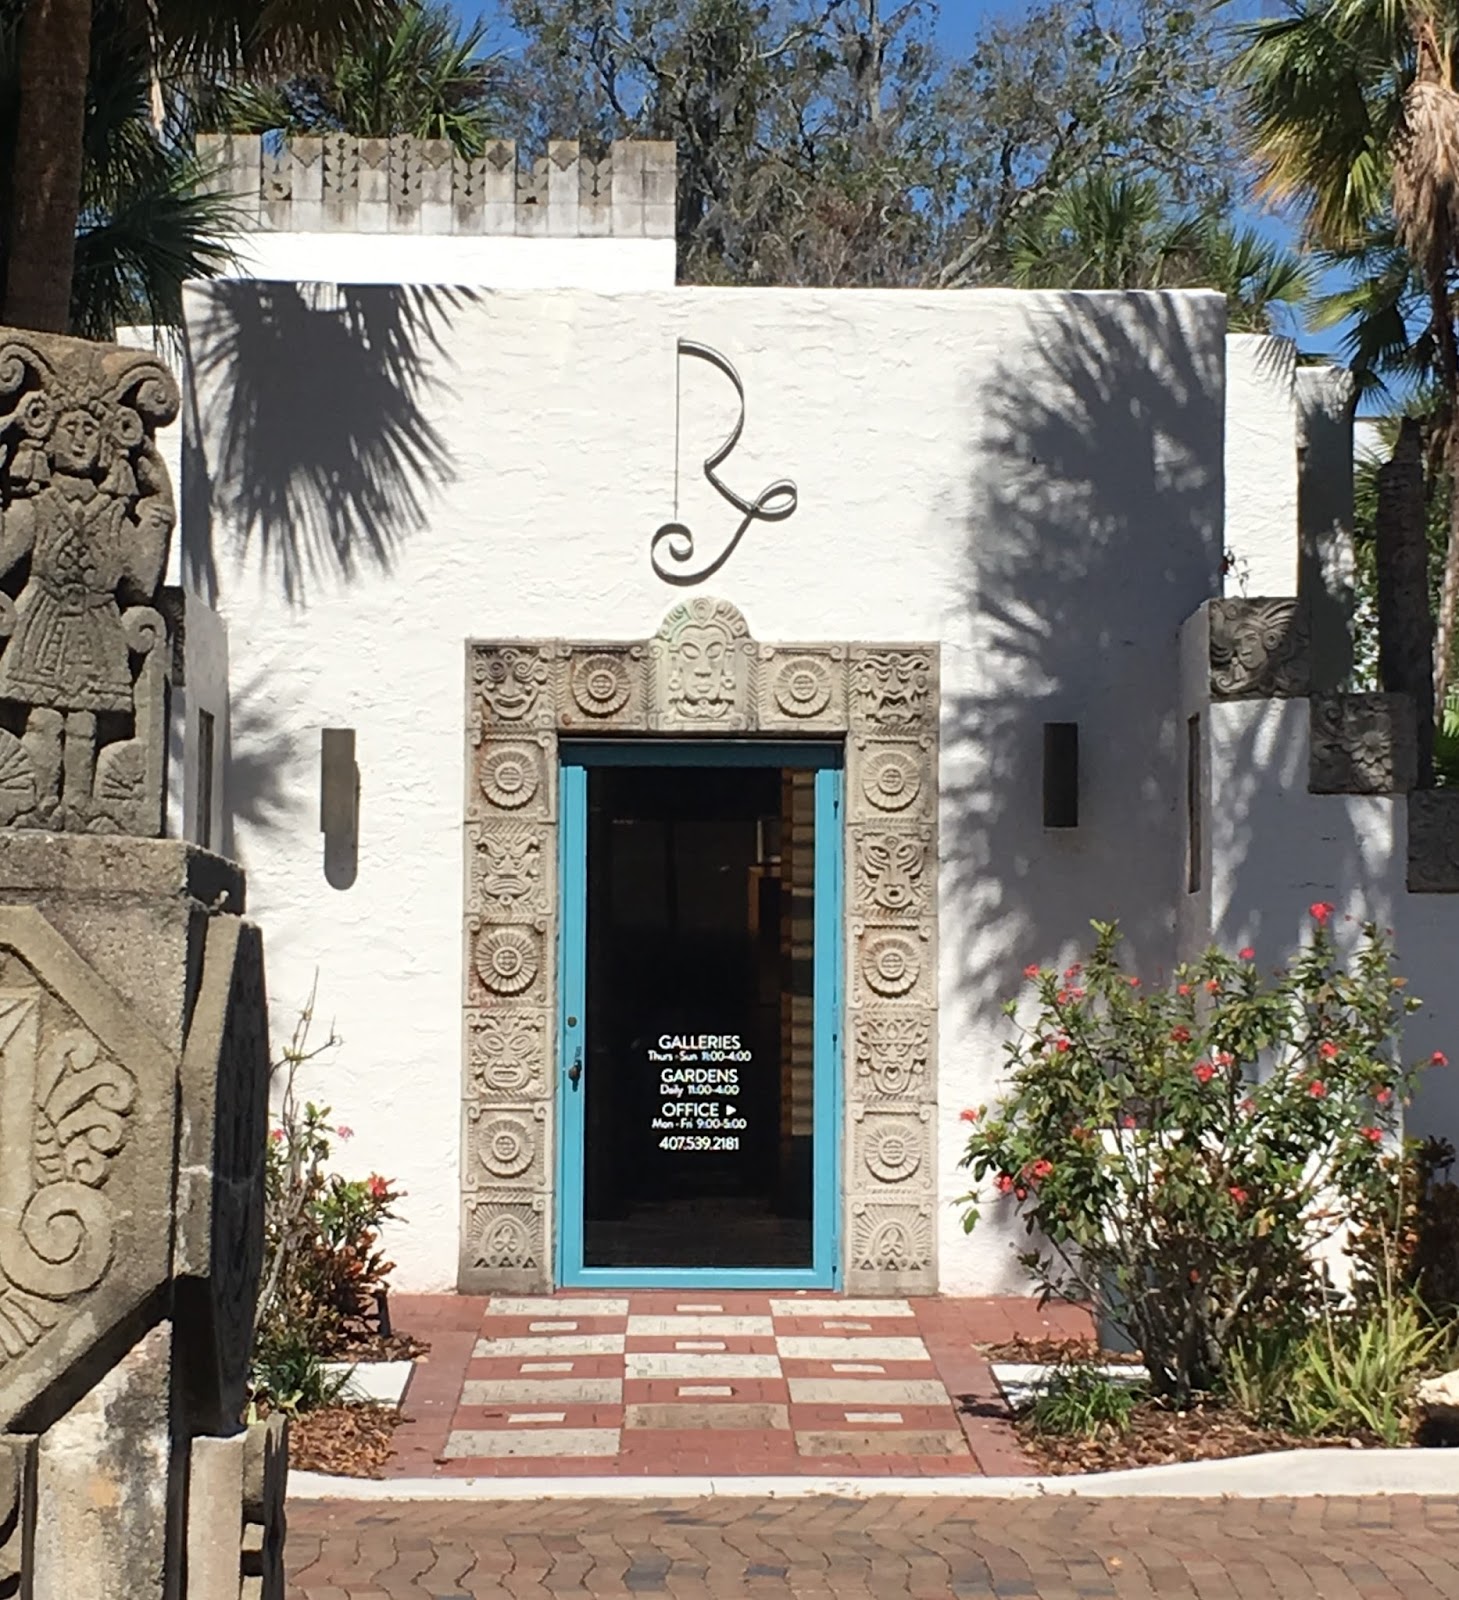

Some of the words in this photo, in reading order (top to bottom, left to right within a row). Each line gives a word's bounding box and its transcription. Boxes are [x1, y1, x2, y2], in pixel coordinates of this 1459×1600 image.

[658, 1034, 742, 1050] GALLERIES
[647, 1050, 674, 1062] Thurs
[679, 1050, 699, 1062] Sun
[660, 1068, 739, 1083] GARDENS
[660, 1084, 684, 1098] Daily
[661, 1102, 720, 1118] OFFICE
[651, 1117, 675, 1129] Mon
[680, 1117, 694, 1129] Fri
[696, 1117, 748, 1130] 9:00-5:00
[658, 1135, 740, 1151] 407.539.2181
